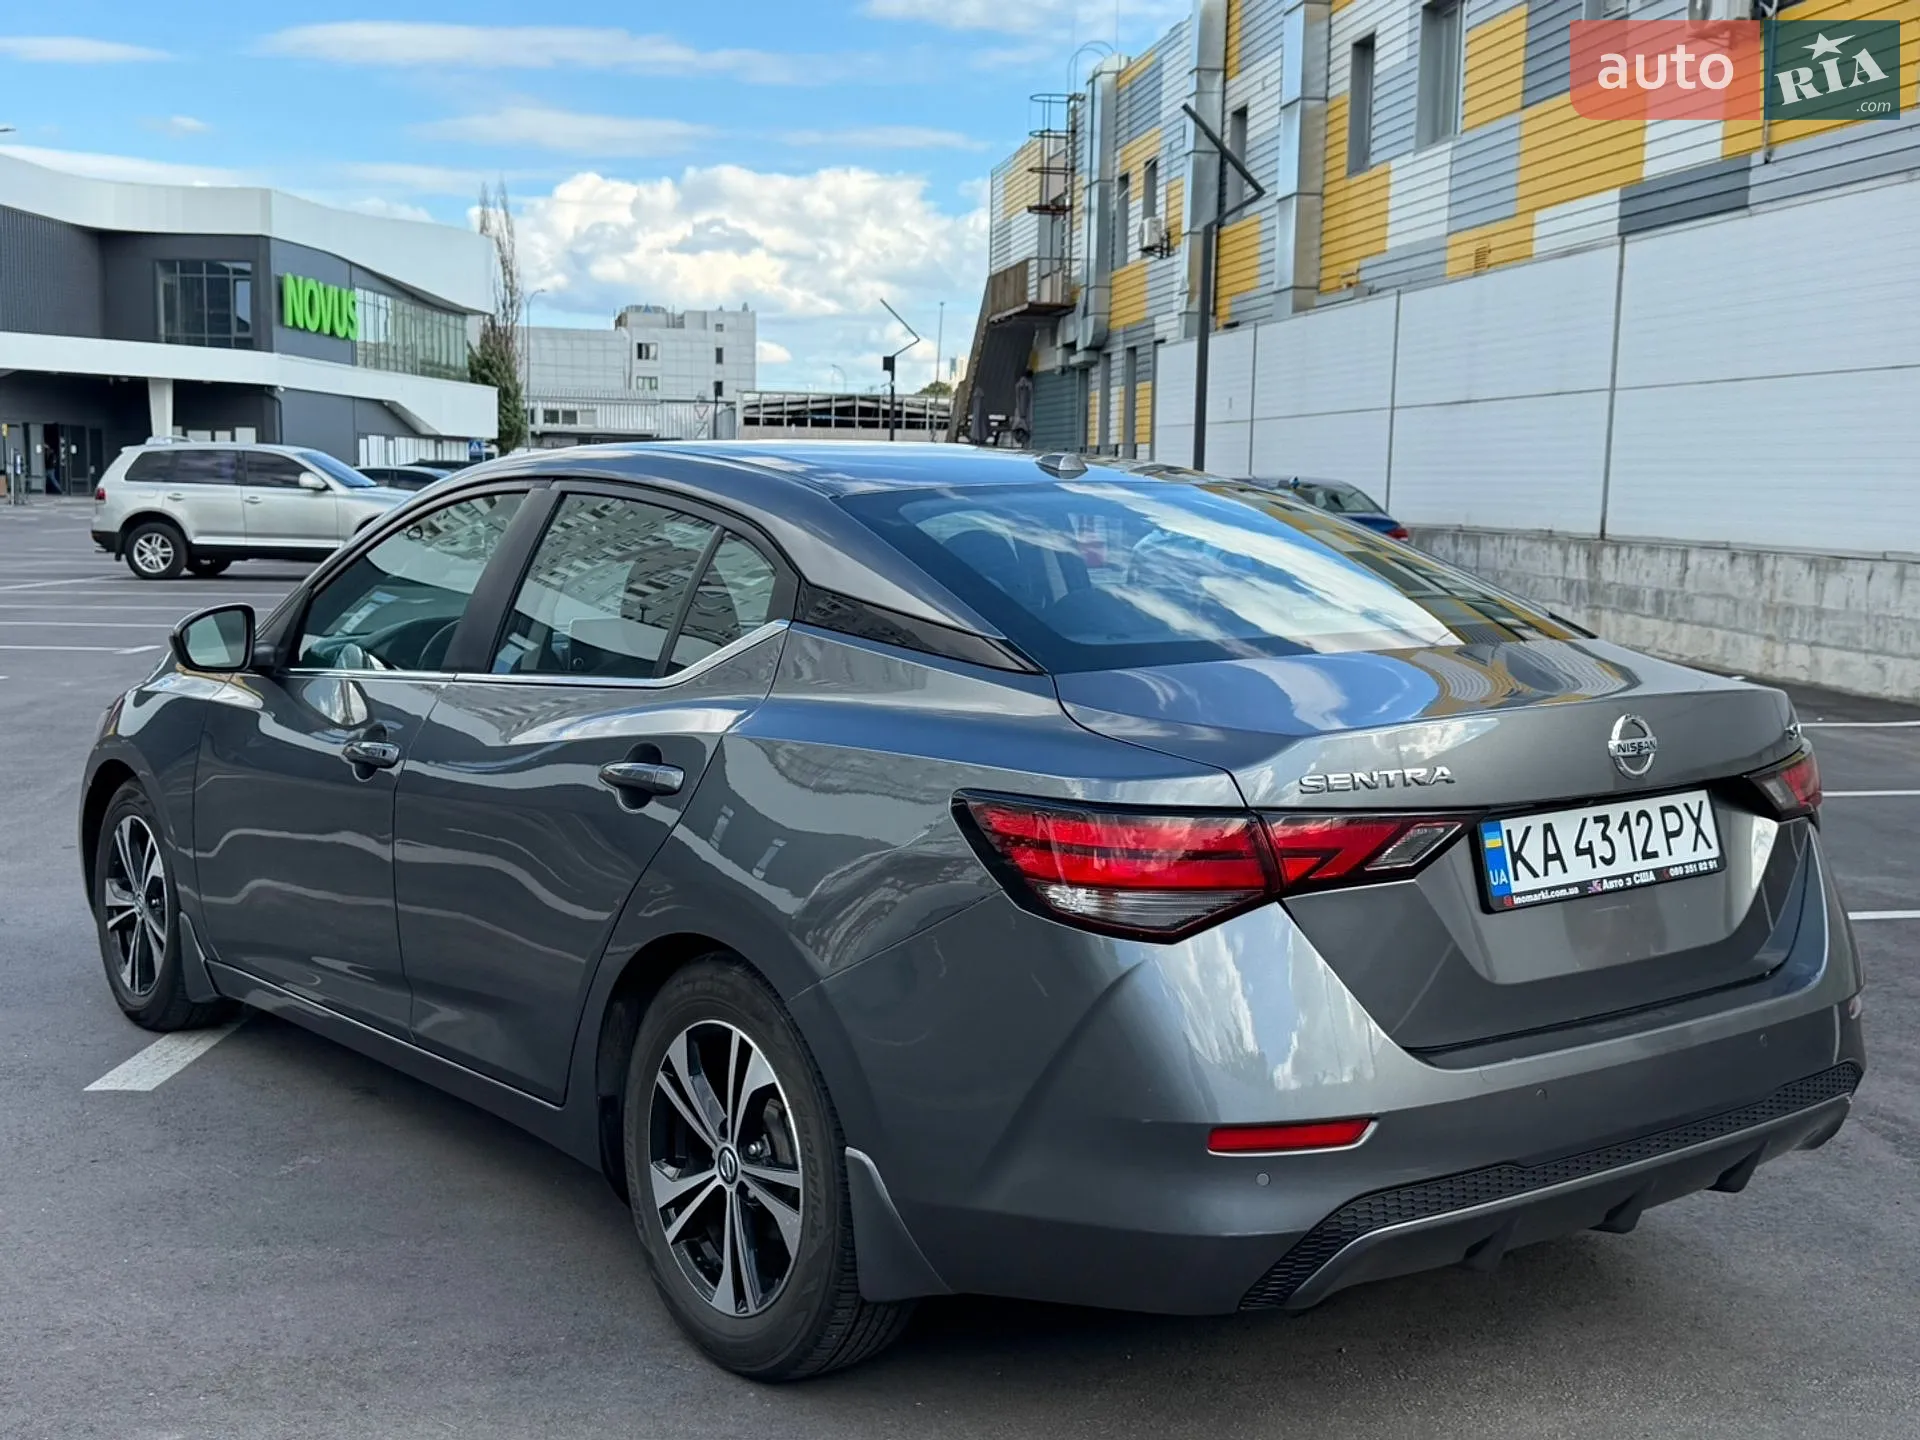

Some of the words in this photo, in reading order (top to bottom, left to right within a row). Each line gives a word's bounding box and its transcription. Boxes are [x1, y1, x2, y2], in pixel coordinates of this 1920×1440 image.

[283, 272, 357, 341] NOVUS
[1617, 739, 1656, 754] NISSAN
[1299, 766, 1455, 795] SENTRA
[1505, 822, 1569, 881] KA
[1573, 809, 1660, 869] 4312
[1659, 800, 1714, 857] PX
[1489, 868, 1509, 886] UA
[1633, 870, 1656, 884] США
